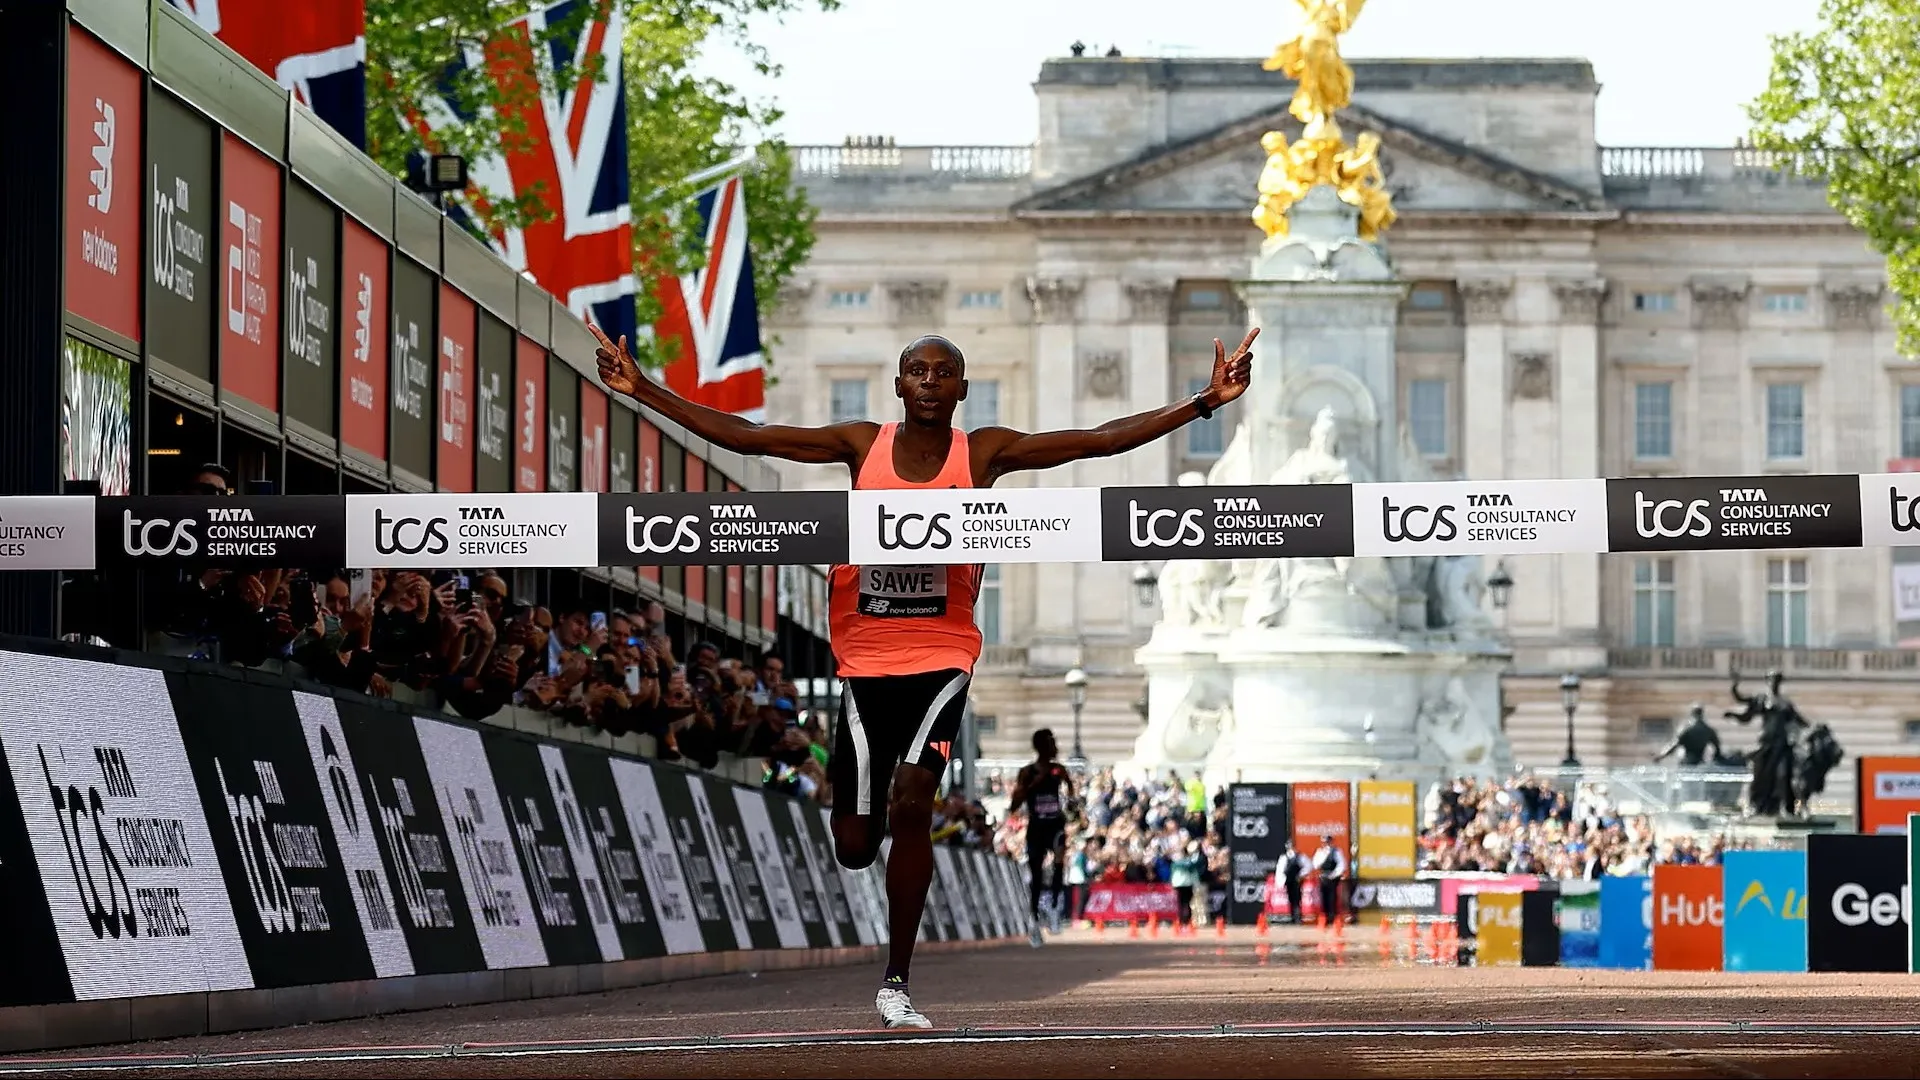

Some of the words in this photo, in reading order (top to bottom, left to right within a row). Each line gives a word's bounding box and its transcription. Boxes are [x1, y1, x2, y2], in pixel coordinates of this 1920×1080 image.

[153, 163, 174, 290] tcs
[289, 247, 306, 358] tcs
[1467, 495, 1512, 506] TATA
[1720, 489, 1767, 502] TATA
[710, 505, 756, 518] TATA
[962, 503, 1007, 514] TATA
[1214, 498, 1261, 511] TATA
[1721, 504, 1830, 519] CONSULTANCY
[208, 509, 253, 521] TATA
[459, 508, 504, 519] TATA
[1383, 497, 1456, 542] tcs
[1468, 510, 1576, 523] CONSULTANCY
[1635, 491, 1711, 537] tcs
[710, 521, 819, 535] CONSULTANCY
[879, 505, 951, 549] tcs
[963, 519, 1070, 531] CONSULTANCY
[1130, 500, 1204, 546] tcs
[1214, 514, 1323, 528] CONSULTANCY
[0, 526, 65, 539] ULTANCY
[124, 509, 197, 556] tcs
[208, 526, 316, 538] CONSULTANCY
[376, 509, 448, 554] tcs
[459, 525, 567, 537] CONSULTANCY
[626, 506, 700, 553] tcs
[1468, 528, 1536, 540] SERVICES
[1722, 522, 1791, 536] SERVICES
[710, 539, 779, 552] SERVICES
[963, 536, 1030, 549] SERVICES
[1215, 532, 1284, 545] SERVICES
[0, 543, 26, 556] CES
[208, 543, 276, 555] SERVICES
[459, 542, 527, 554] SERVICES
[870, 569, 933, 593] SAWE
[907, 606, 938, 614] balance
[93, 746, 137, 798] TATA
[253, 760, 285, 804] TATA
[37, 743, 137, 940] tcs
[116, 818, 193, 868] CONSULTANCY
[214, 756, 296, 934] tcs
[273, 824, 328, 868] CONSULTANCY
[136, 887, 191, 937] SERVICES
[290, 886, 331, 932] SERVICES
[1661, 892, 1724, 927] Hub
